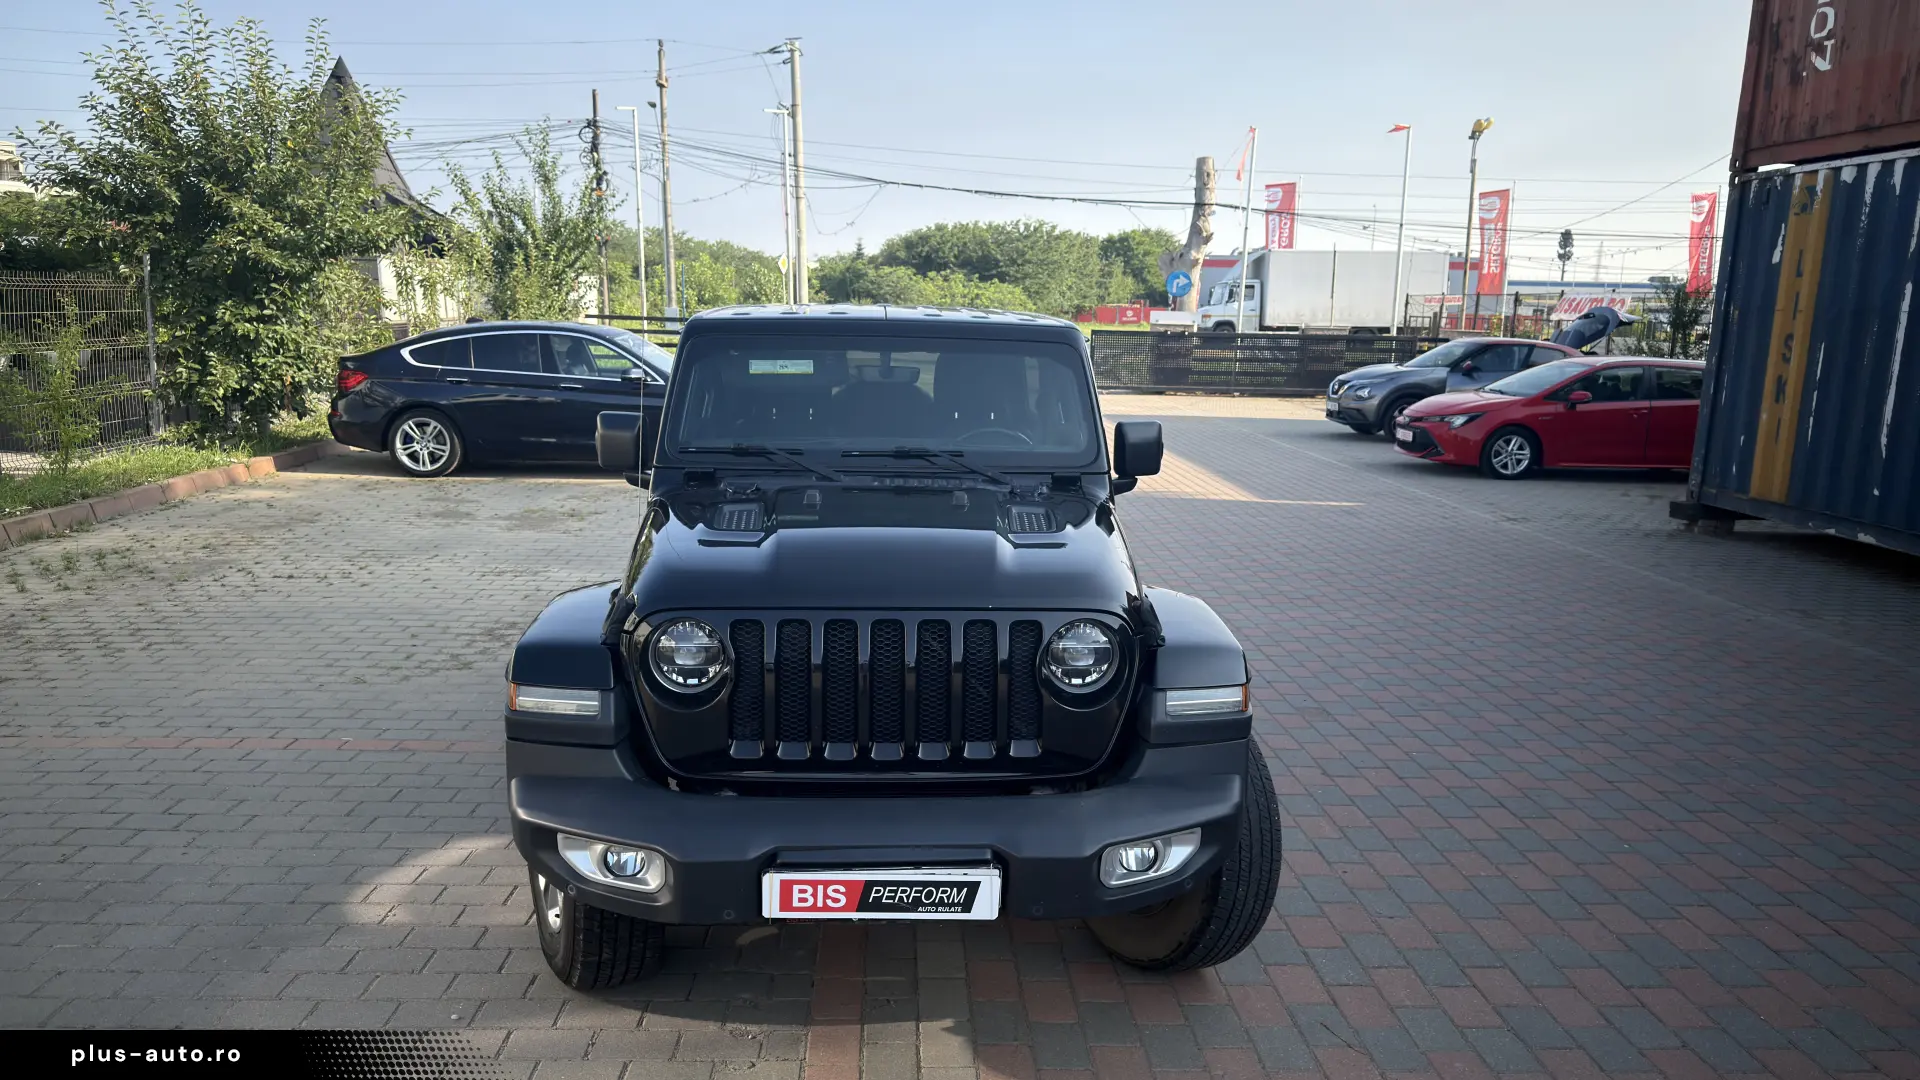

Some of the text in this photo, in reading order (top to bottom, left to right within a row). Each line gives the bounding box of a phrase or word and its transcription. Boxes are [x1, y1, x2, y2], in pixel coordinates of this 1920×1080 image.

[1775, 249, 1803, 444] LISKI
[792, 884, 967, 908] BIS PERFORM
